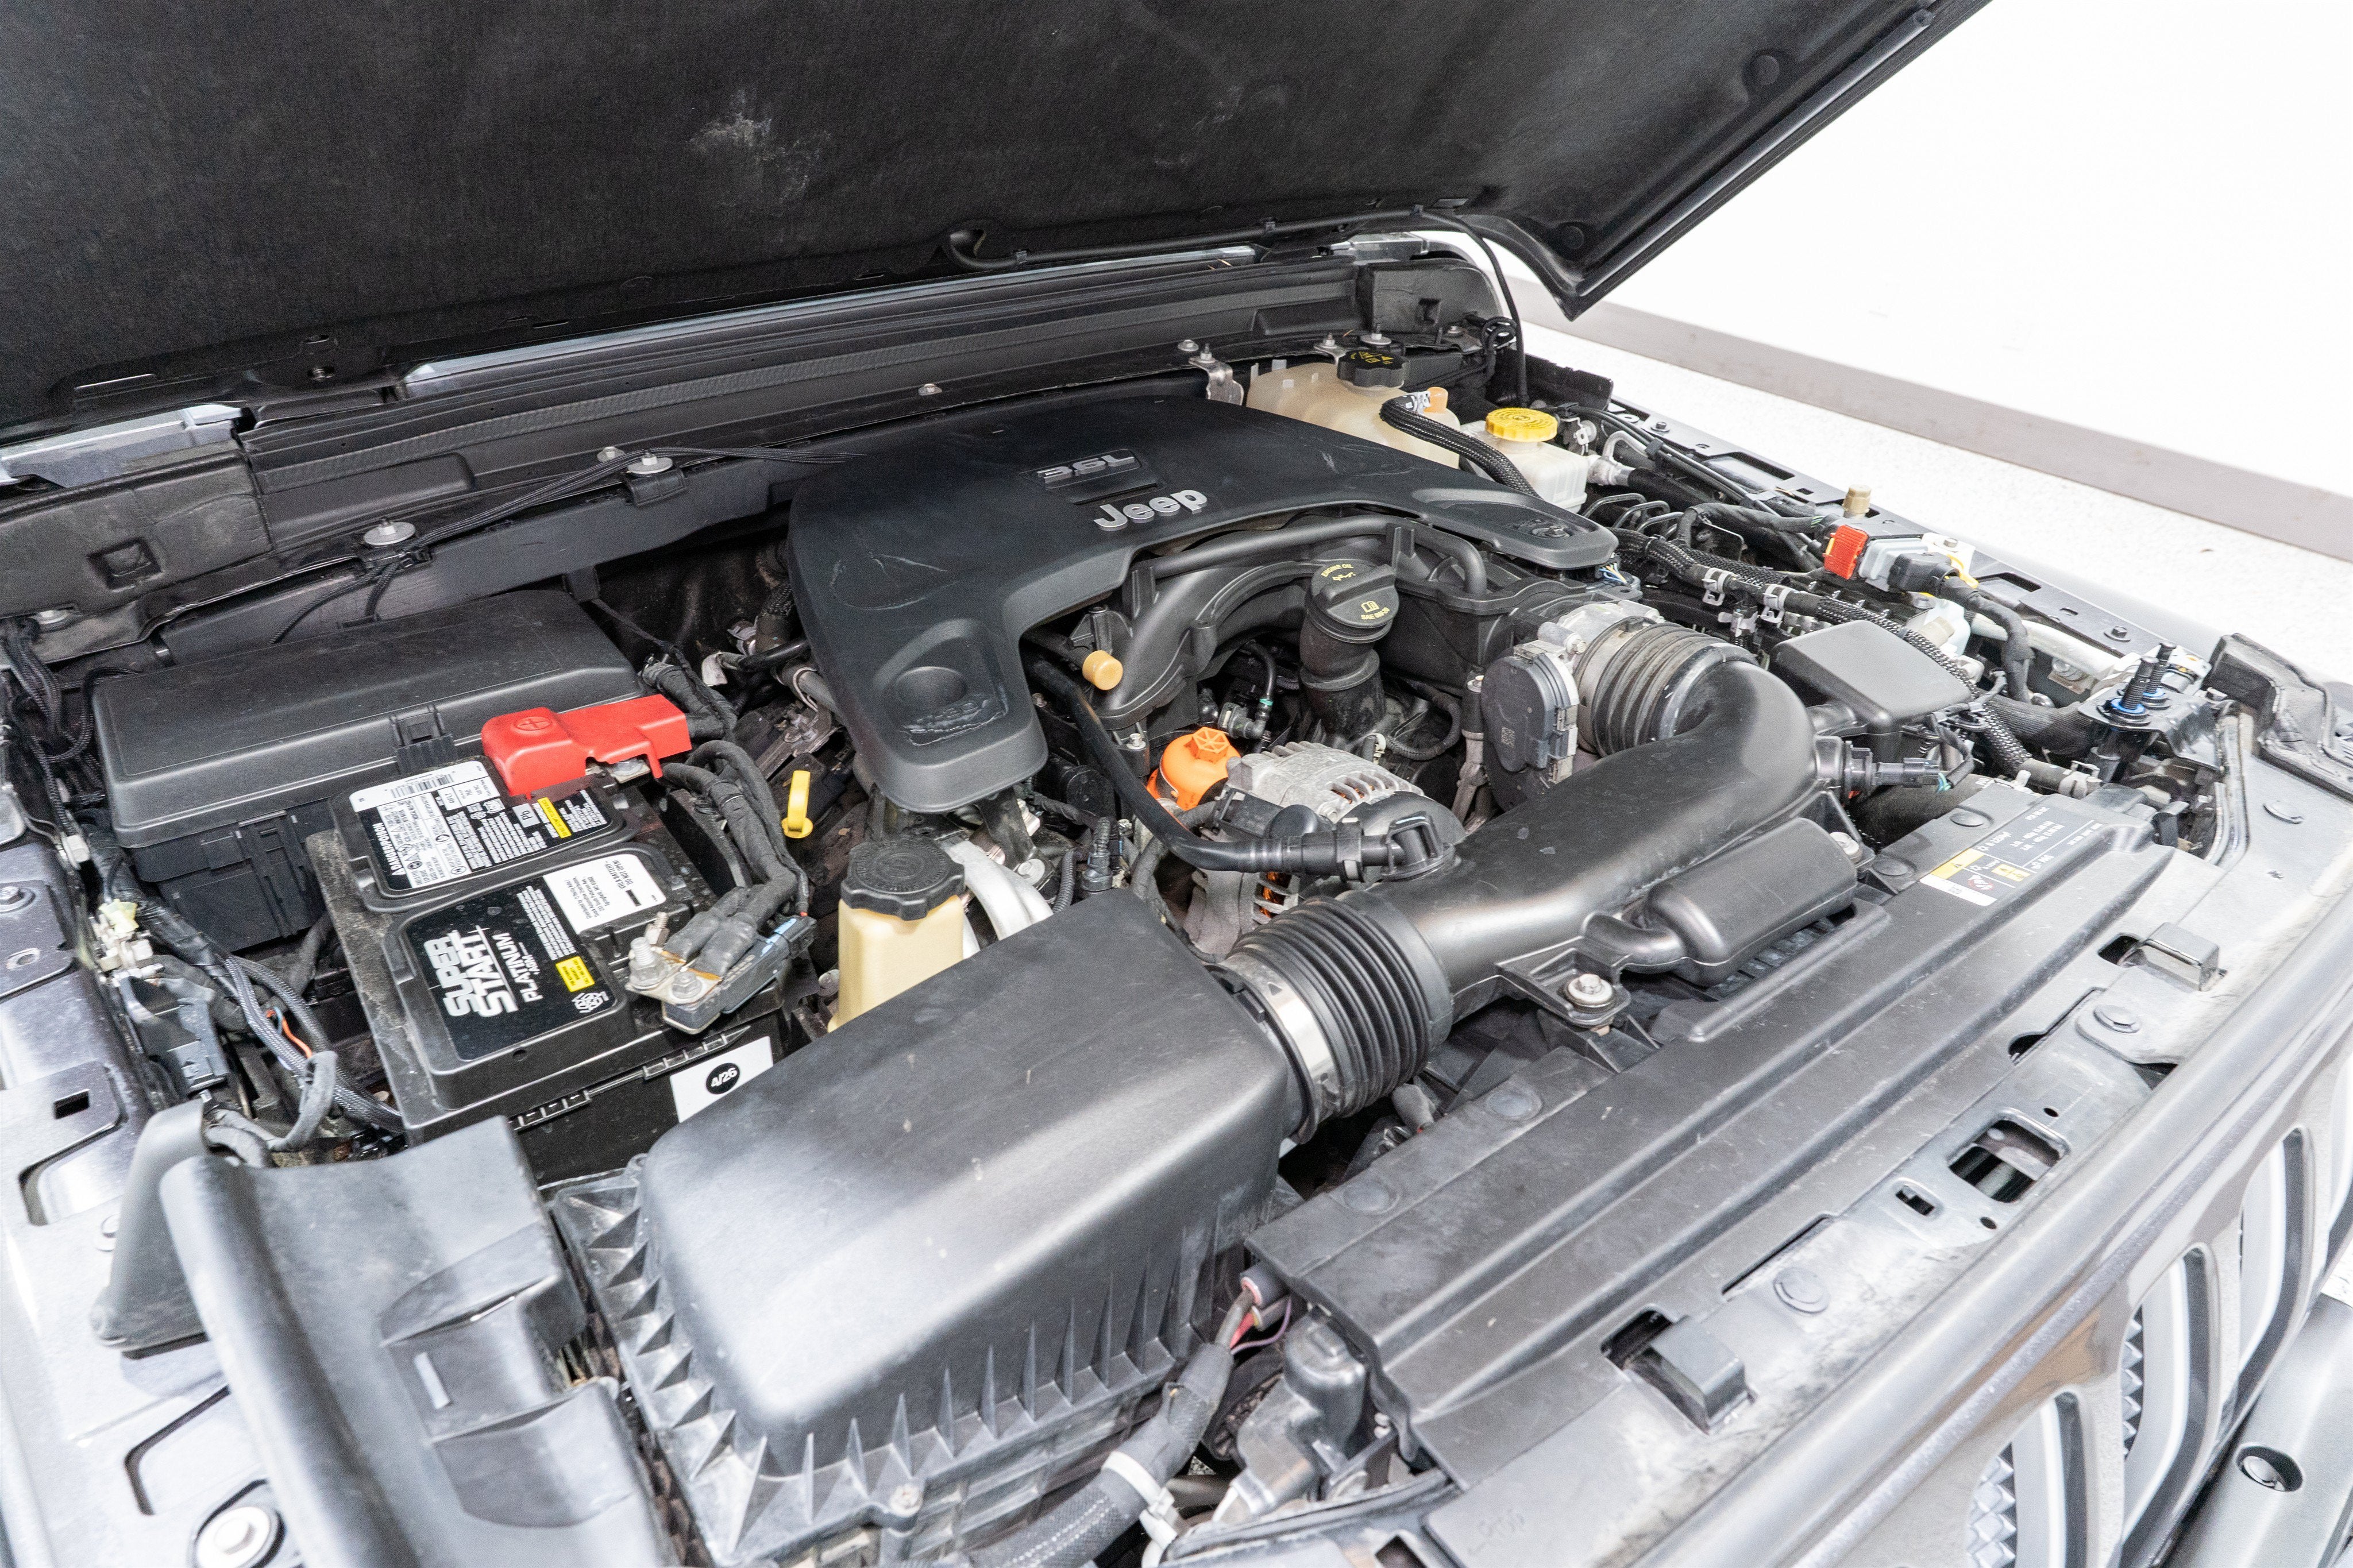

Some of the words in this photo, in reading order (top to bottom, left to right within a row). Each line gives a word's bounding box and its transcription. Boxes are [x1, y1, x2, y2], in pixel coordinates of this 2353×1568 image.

[1037, 455, 1135, 484] 3.6L
[1093, 489, 1208, 537] Jeep
[1321, 564, 1343, 577] ENGINE
[520, 810, 532, 820] Pb
[372, 822, 405, 870] DANGER/POISON
[605, 863, 619, 879] BATTERY
[615, 878, 626, 889] VRLA
[579, 903, 592, 918] Distributed
[583, 893, 593, 908] Automotive
[493, 932, 544, 1003] PLATINUM
[522, 953, 539, 974] AGM
[425, 936, 473, 1017] SUPER
[446, 931, 518, 1018] START
[710, 1067, 738, 1087] 4/26
